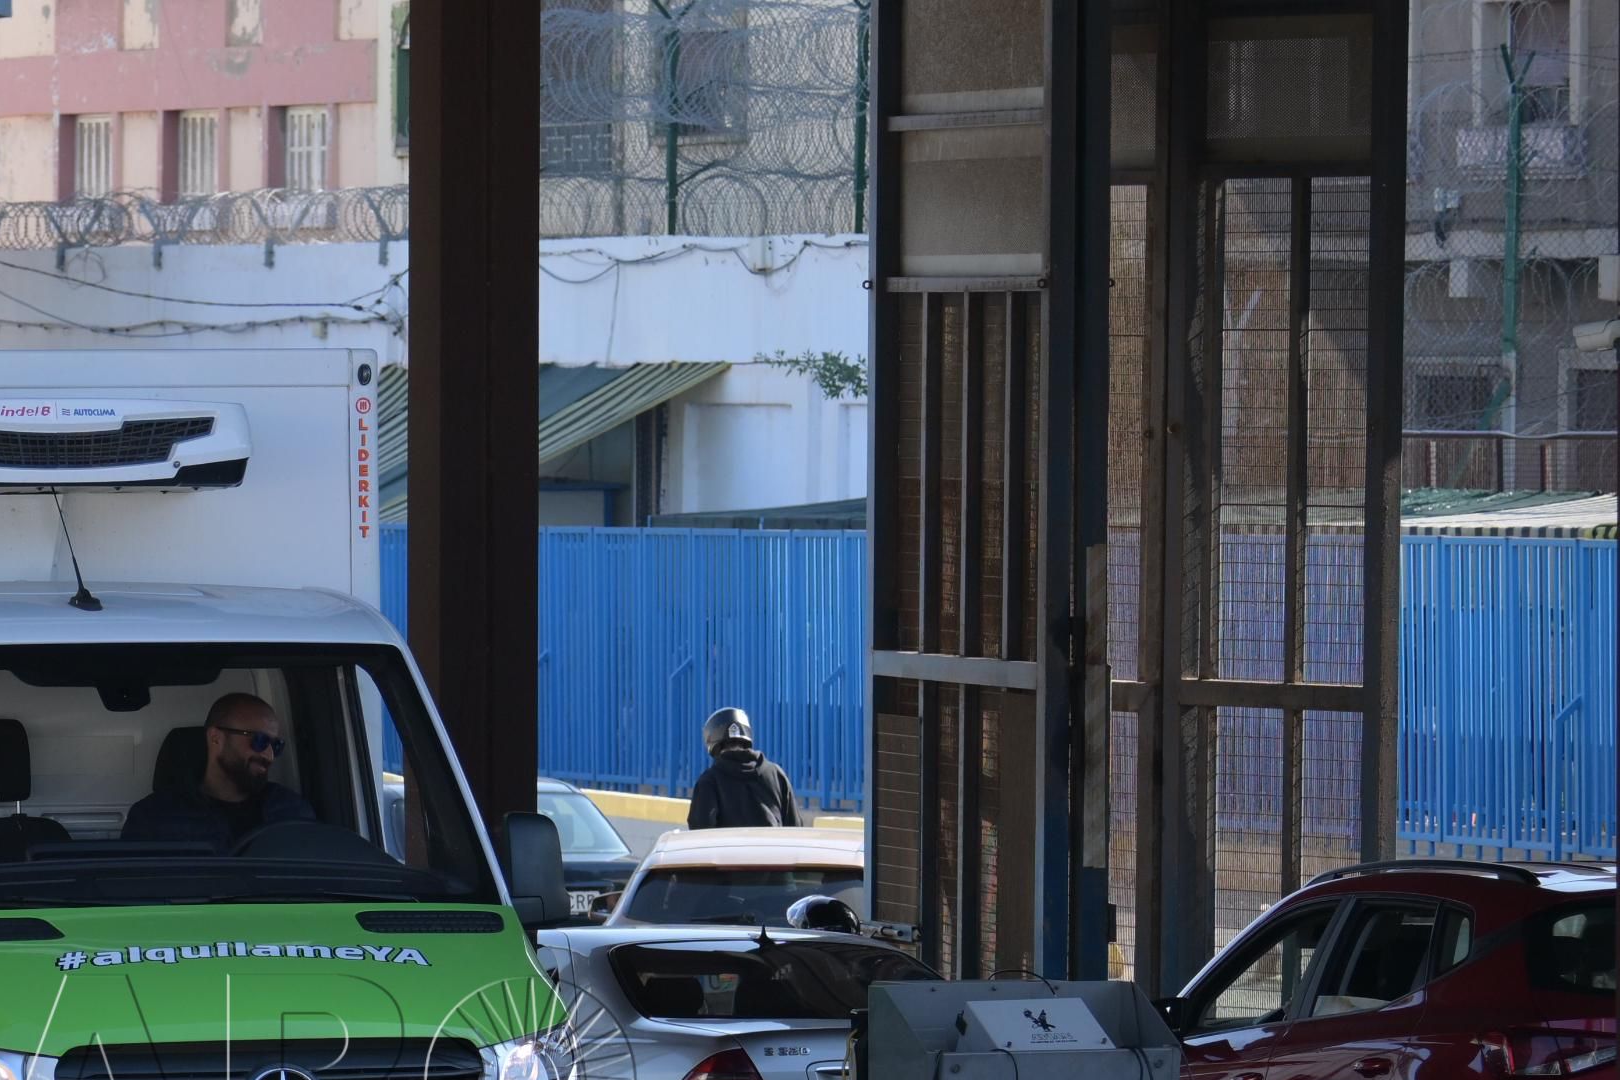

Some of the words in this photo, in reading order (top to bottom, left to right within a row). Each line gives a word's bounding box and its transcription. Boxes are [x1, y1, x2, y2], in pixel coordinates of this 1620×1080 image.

[73, 408, 116, 417] AUTOCLIMA
[357, 418, 370, 539] LIDERKIT
[55, 941, 433, 971] #alquilameYA
